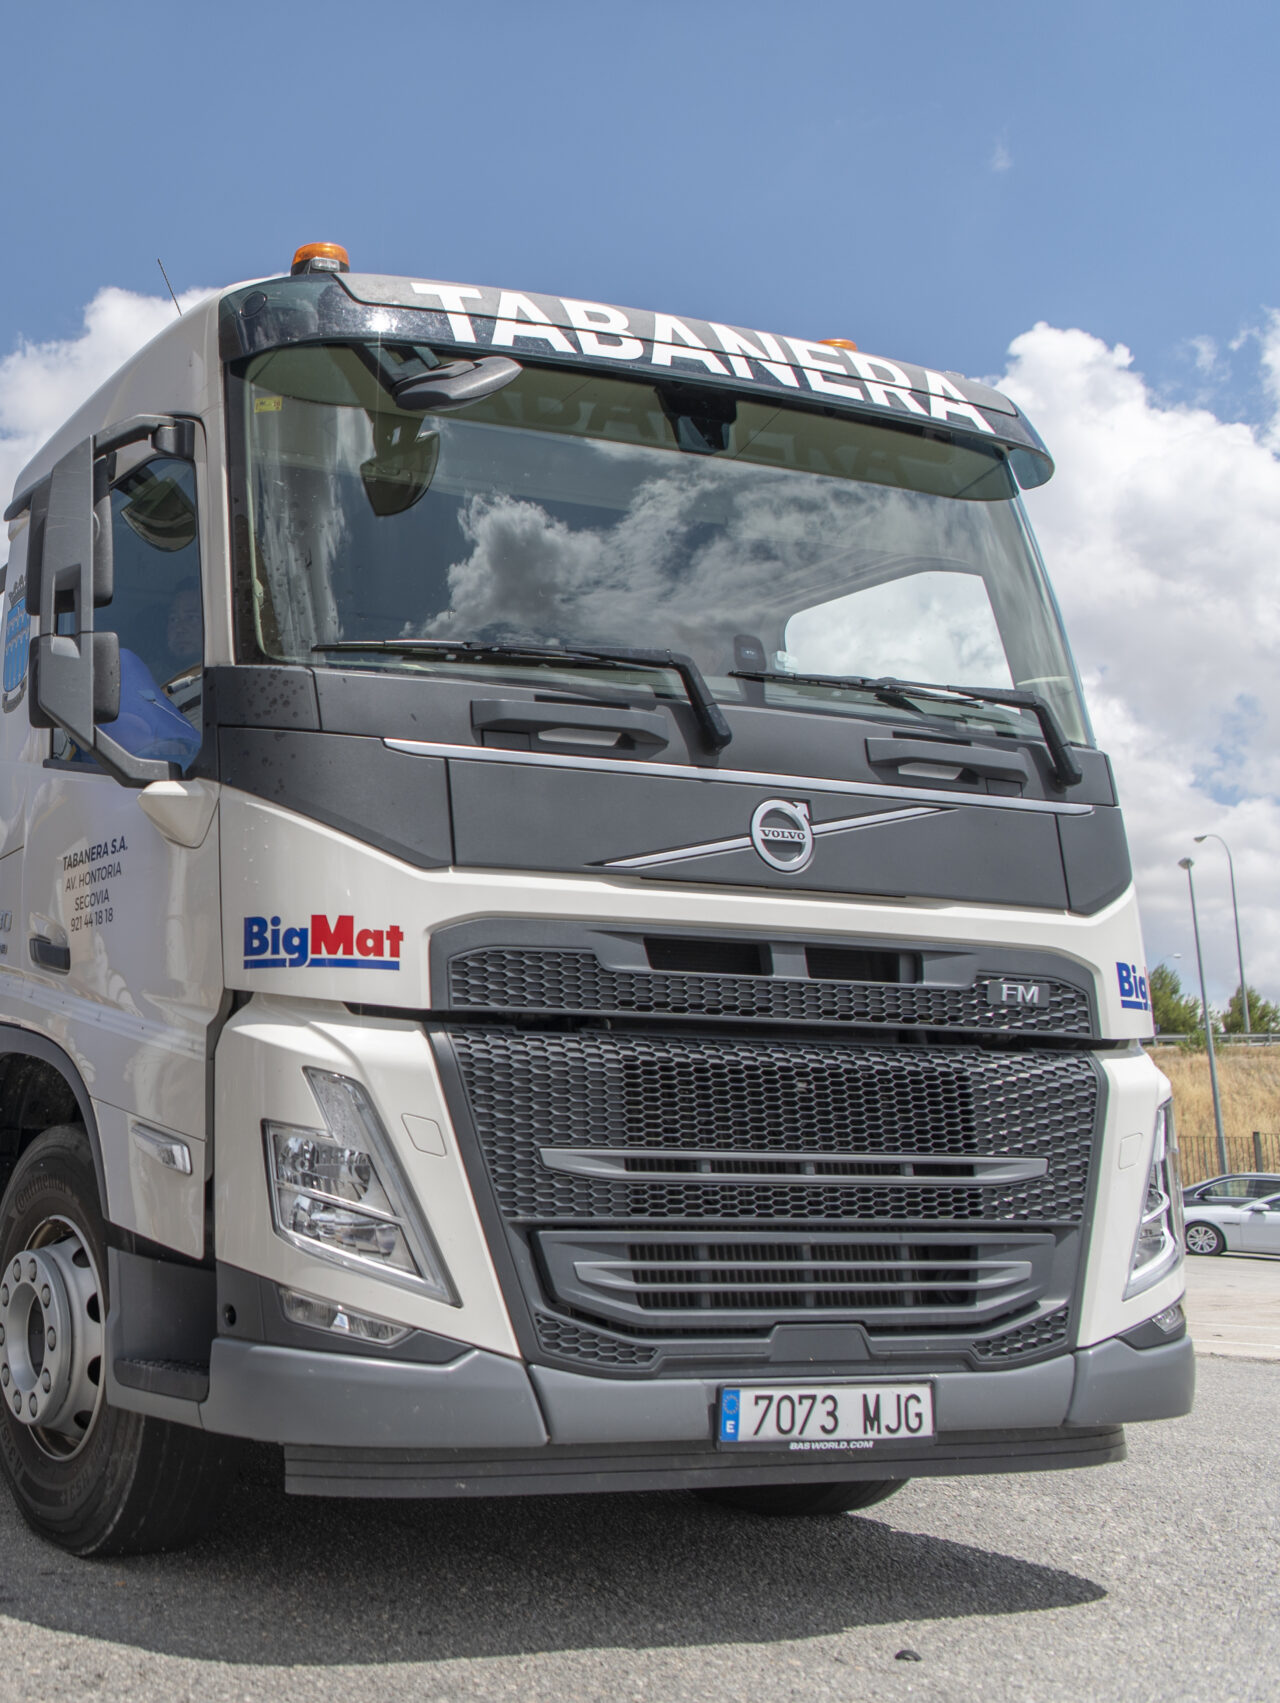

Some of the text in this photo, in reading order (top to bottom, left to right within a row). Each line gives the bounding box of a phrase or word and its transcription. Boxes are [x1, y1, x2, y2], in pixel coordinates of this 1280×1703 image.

[409, 282, 996, 435] TABANERA
[760, 829, 806, 841] VOLVO
[63, 841, 109, 872] TABANERA
[79, 861, 122, 888] HONTORIA
[243, 914, 404, 968] BigMat
[1001, 984, 1039, 1004] FM
[1116, 962, 1149, 1011] Big
[726, 1393, 923, 1436] E 7073 MJG
